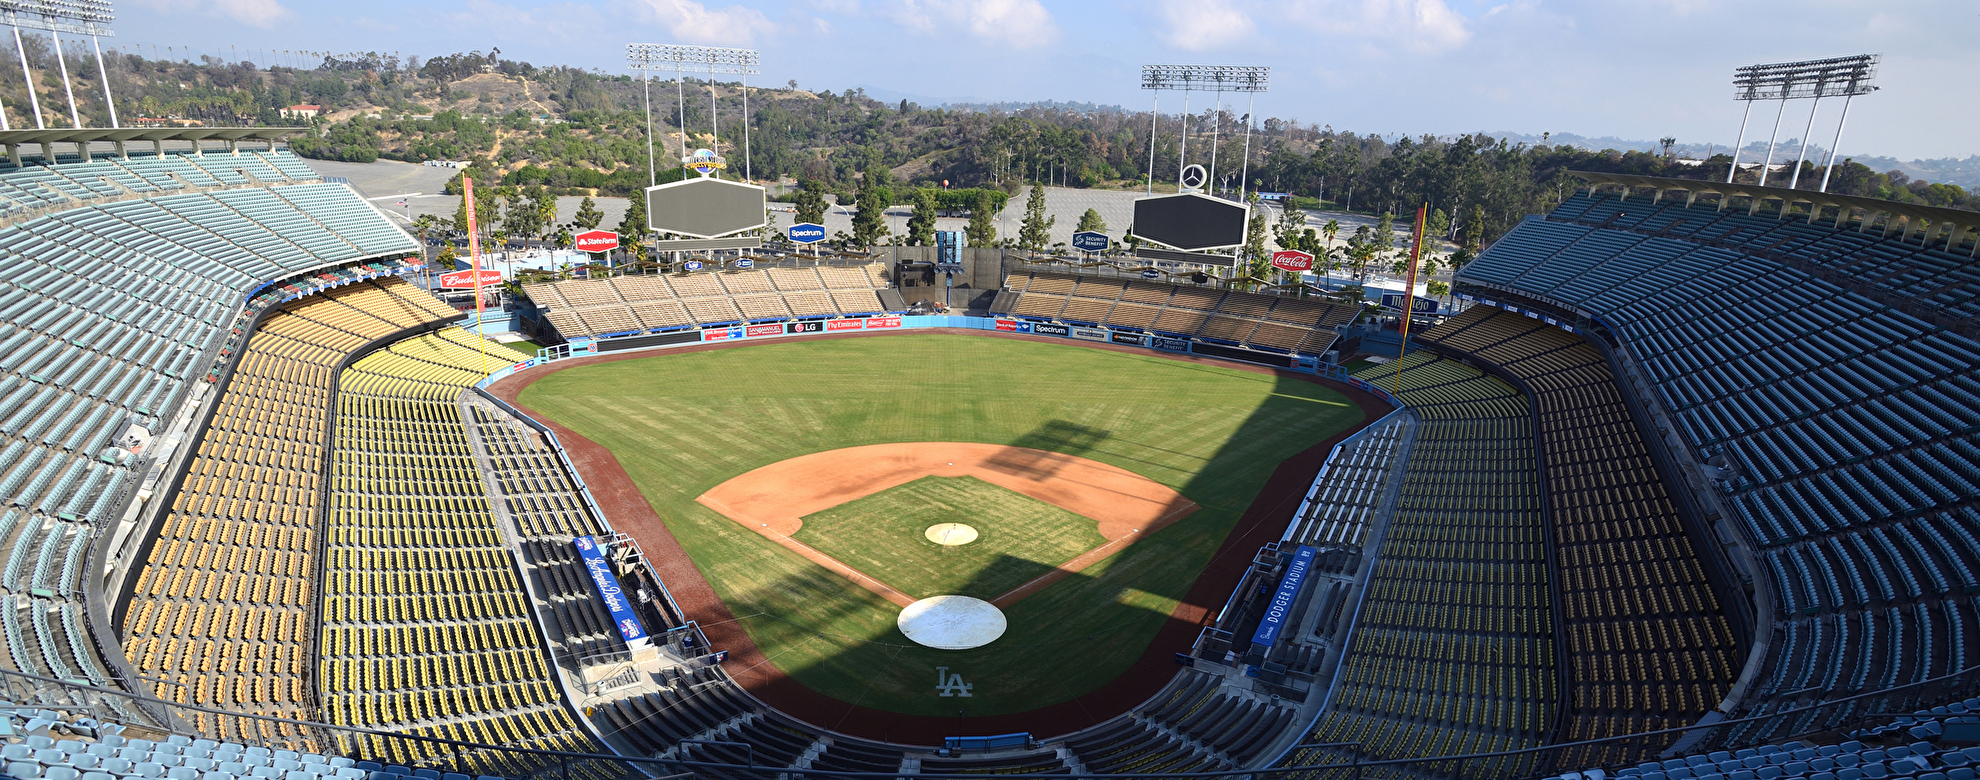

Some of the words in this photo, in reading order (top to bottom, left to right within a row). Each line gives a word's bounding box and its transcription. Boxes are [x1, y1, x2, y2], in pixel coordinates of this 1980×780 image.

[466, 189, 474, 211] Emirates
[791, 229, 822, 238] Spectrum
[805, 323, 816, 331] LG
[838, 320, 862, 328] Emirates
[1035, 325, 1066, 335] Spectrum
[602, 586, 624, 612] Dodgers
[1267, 591, 1292, 624] DODGER
[1283, 560, 1307, 590] STADIUM
[935, 666, 973, 697] LA
